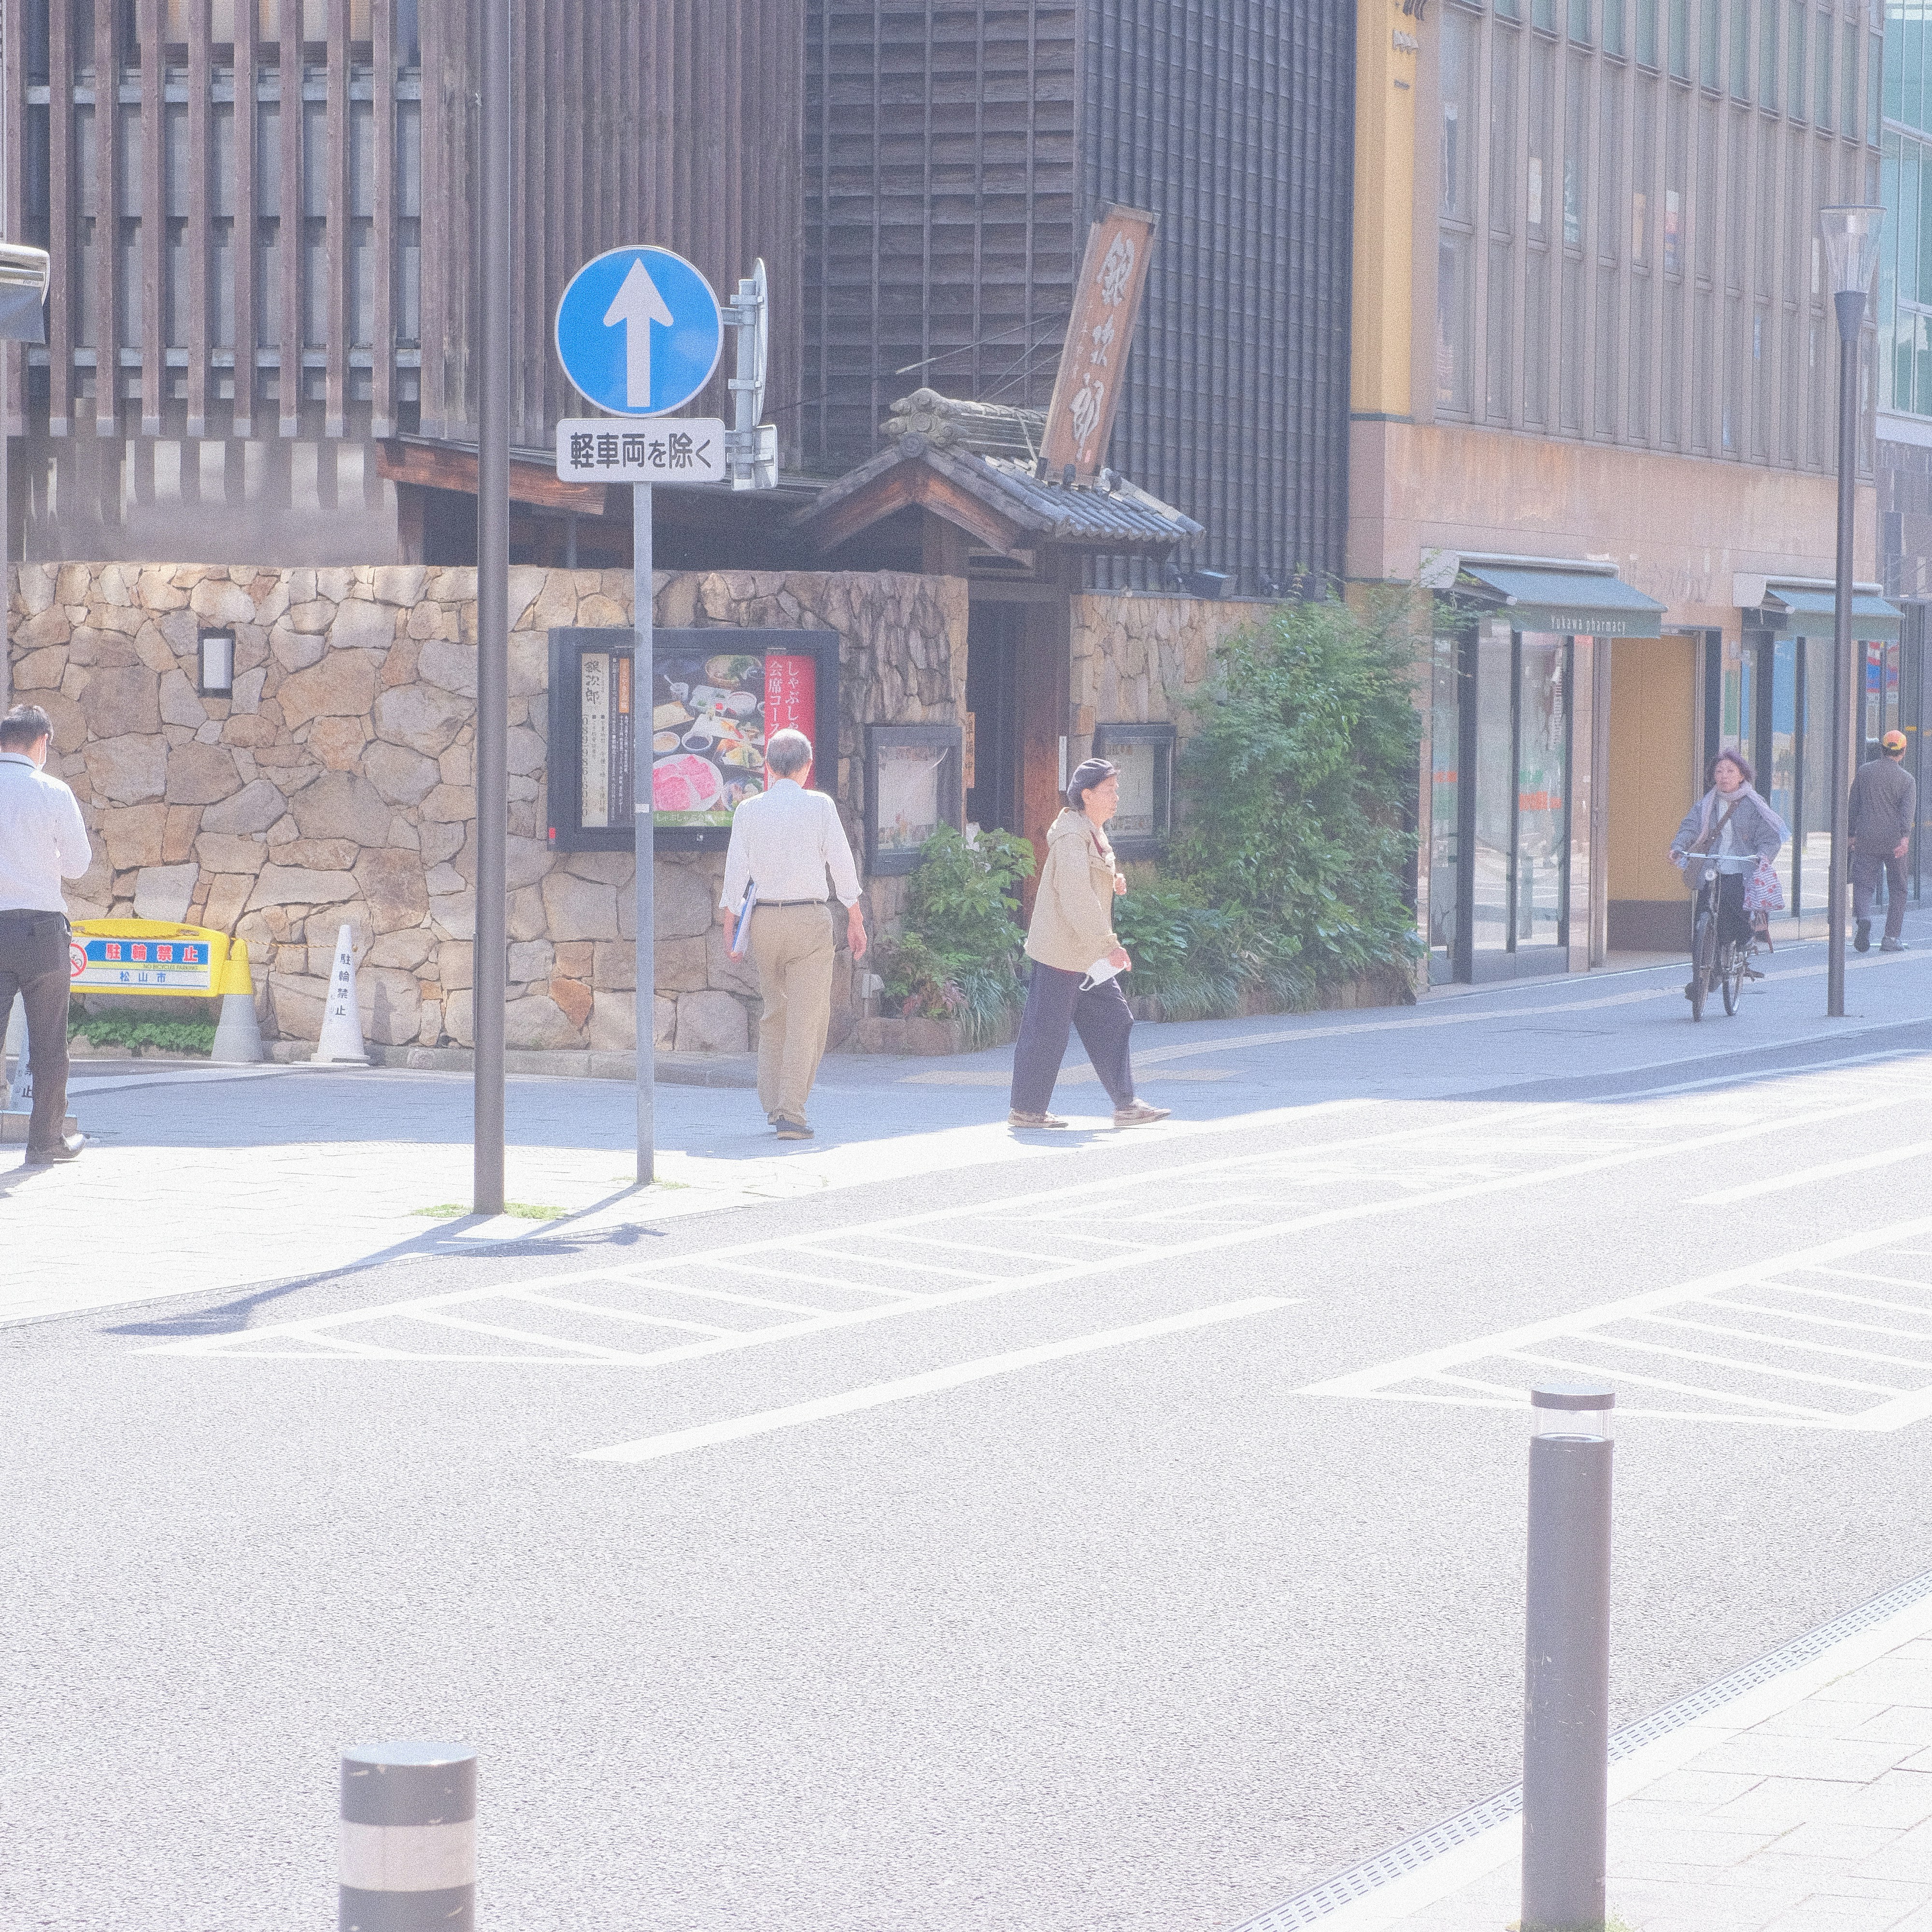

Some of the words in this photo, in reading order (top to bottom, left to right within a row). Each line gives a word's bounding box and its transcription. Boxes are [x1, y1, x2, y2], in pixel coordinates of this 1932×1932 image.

[570, 432, 712, 469] 軽車両を除く
[1551, 615, 1583, 630] Yukawa
[1586, 618, 1627, 634] pharmacy
[584, 660, 601, 705] 銀次郎
[106, 943, 199, 963] 駐輪禁止
[120, 970, 167, 984] 松山市
[335, 953, 351, 1016] 駐輪禁止
